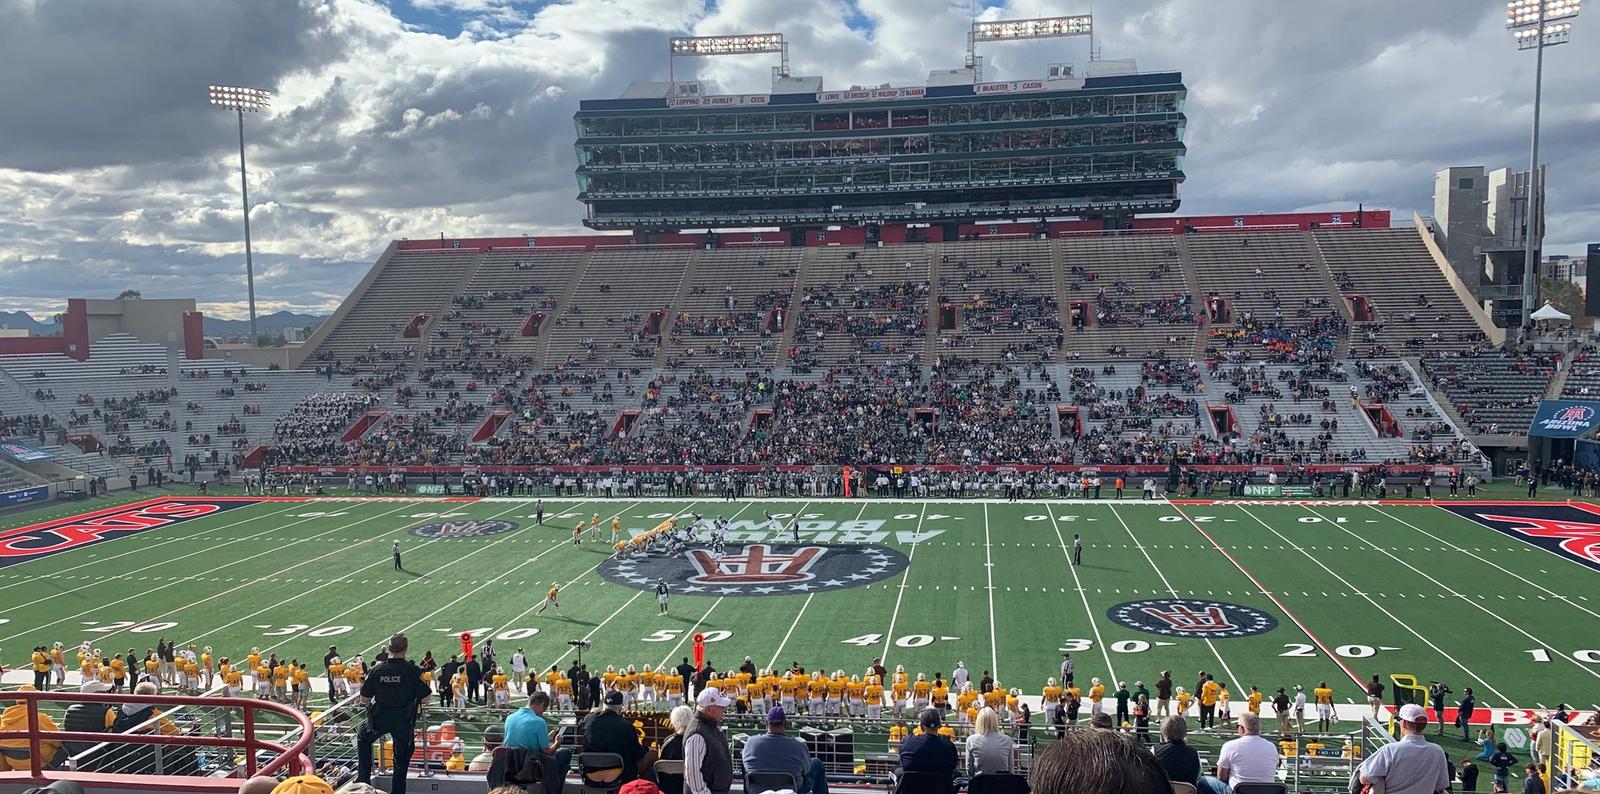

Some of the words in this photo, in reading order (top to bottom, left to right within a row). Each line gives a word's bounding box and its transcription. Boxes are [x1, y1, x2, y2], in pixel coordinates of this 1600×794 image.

[1538, 419, 1590, 428] ARIZONA
[1544, 424, 1578, 432] BOWL
[1253, 486, 1275, 495] NFP
[0, 502, 221, 558] CATS
[80, 621, 179, 633] 20
[262, 623, 354, 637] 30
[446, 627, 541, 641] 40
[641, 629, 734, 643] 50
[841, 633, 936, 648] 40
[1058, 638, 1151, 653] 30
[1278, 643, 1377, 658] 20
[380, 675, 401, 683] POLICE
